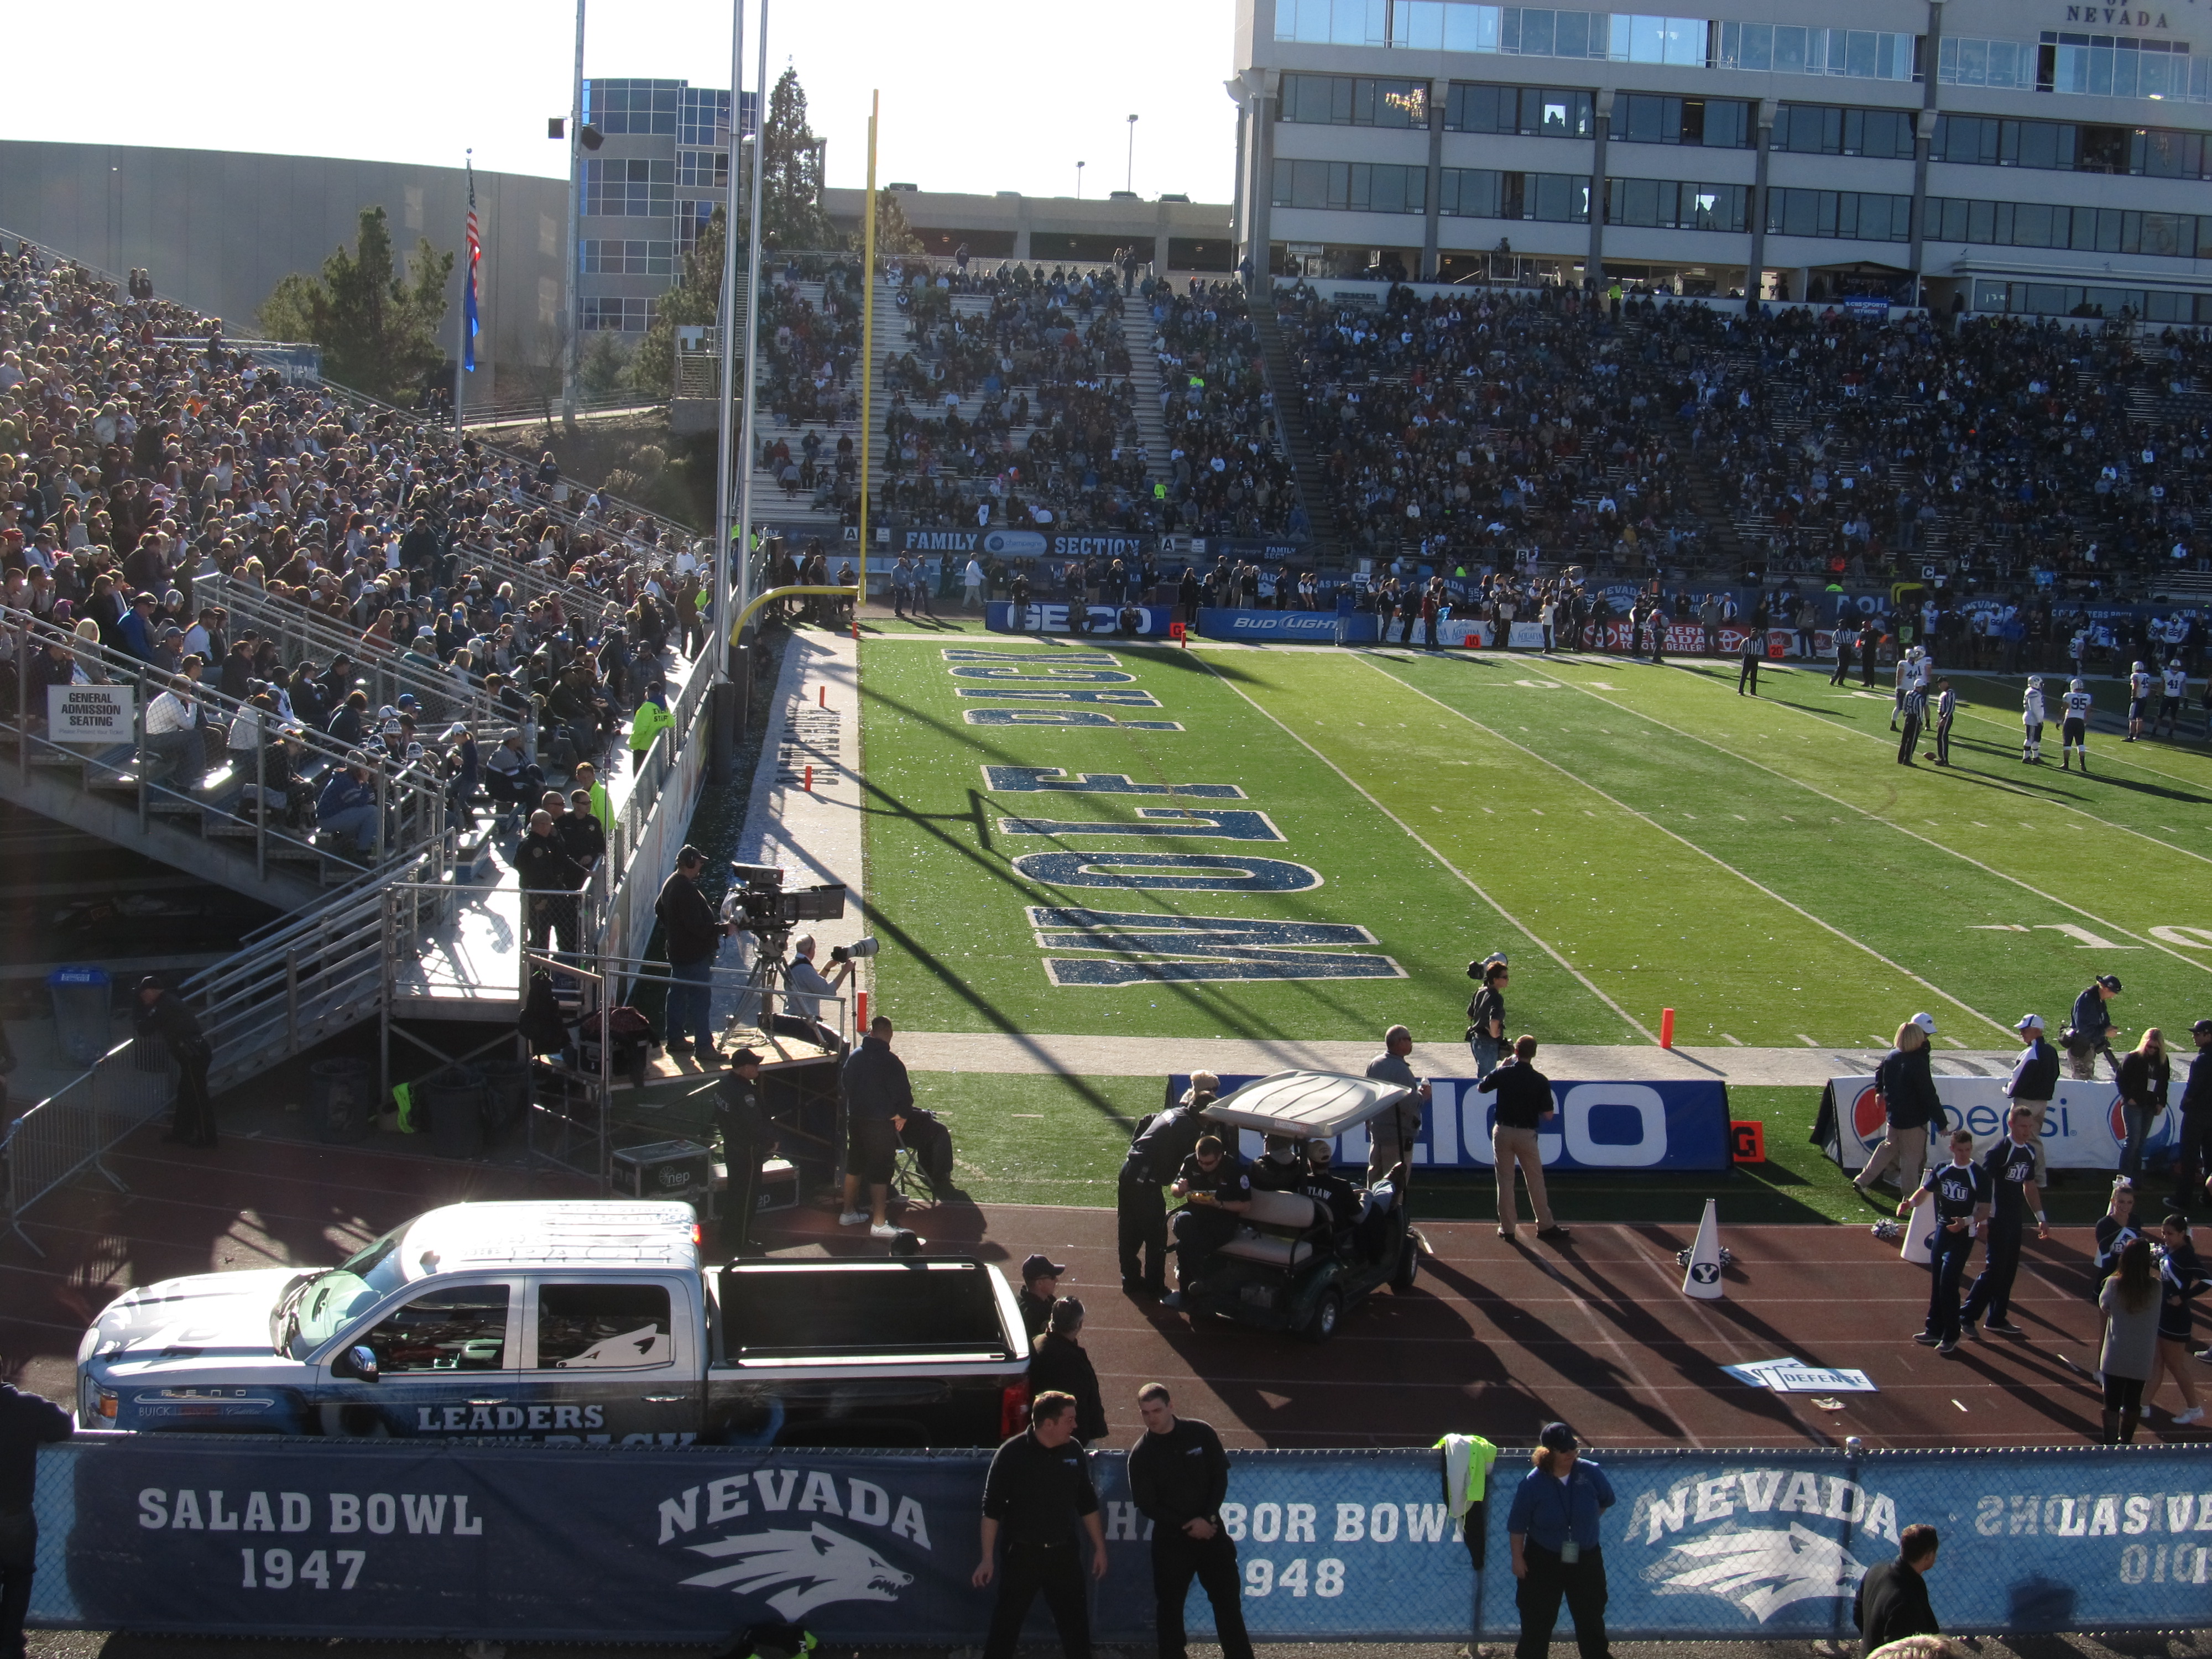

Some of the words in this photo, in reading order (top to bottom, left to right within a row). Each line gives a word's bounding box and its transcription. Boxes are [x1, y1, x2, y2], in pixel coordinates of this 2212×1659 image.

[2067, 6, 2168, 28] NEVADA
[846, 528, 857, 539] A
[906, 531, 978, 551] FAMILY
[1006, 539, 1042, 549] champagne
[1163, 539, 1174, 551] A
[1923, 567, 1933, 578] C
[1007, 604, 1152, 634] GECO
[1233, 617, 1279, 629] BUD
[1173, 624, 1182, 635] G
[1452, 628, 1480, 638] AQUAFINA
[1469, 636, 1478, 646] 10
[1771, 646, 1783, 656] 20
[941, 648, 1186, 731] PACK
[2167, 680, 2179, 689] 41
[69, 692, 113, 703] GENERAL
[2071, 697, 2087, 711] 95
[61, 704, 121, 715] ADMISSION
[70, 716, 113, 727] SEATING
[980, 764, 1410, 987] WOLF
[1736, 1126, 1756, 1156] G
[667, 1171, 690, 1185] nep
[1941, 1179, 1969, 1202] BYU
[1783, 1373, 1867, 1384] DEFENSE
[139, 1406, 170, 1416] BUICK
[226, 1406, 262, 1416] Cadillac
[418, 1404, 604, 1431] LEADERS
[138, 1487, 312, 1533] SALAD
[330, 1493, 483, 1535] BOWL
[658, 1469, 931, 1551] NEVADA
[1645, 1470, 1900, 1546] NEVADA
[1106, 1501, 1316, 1542] HBOR
[2058, 1495, 2152, 1536] LAS
[242, 1548, 366, 1589] 1947
[1244, 1558, 1345, 1597] 948
